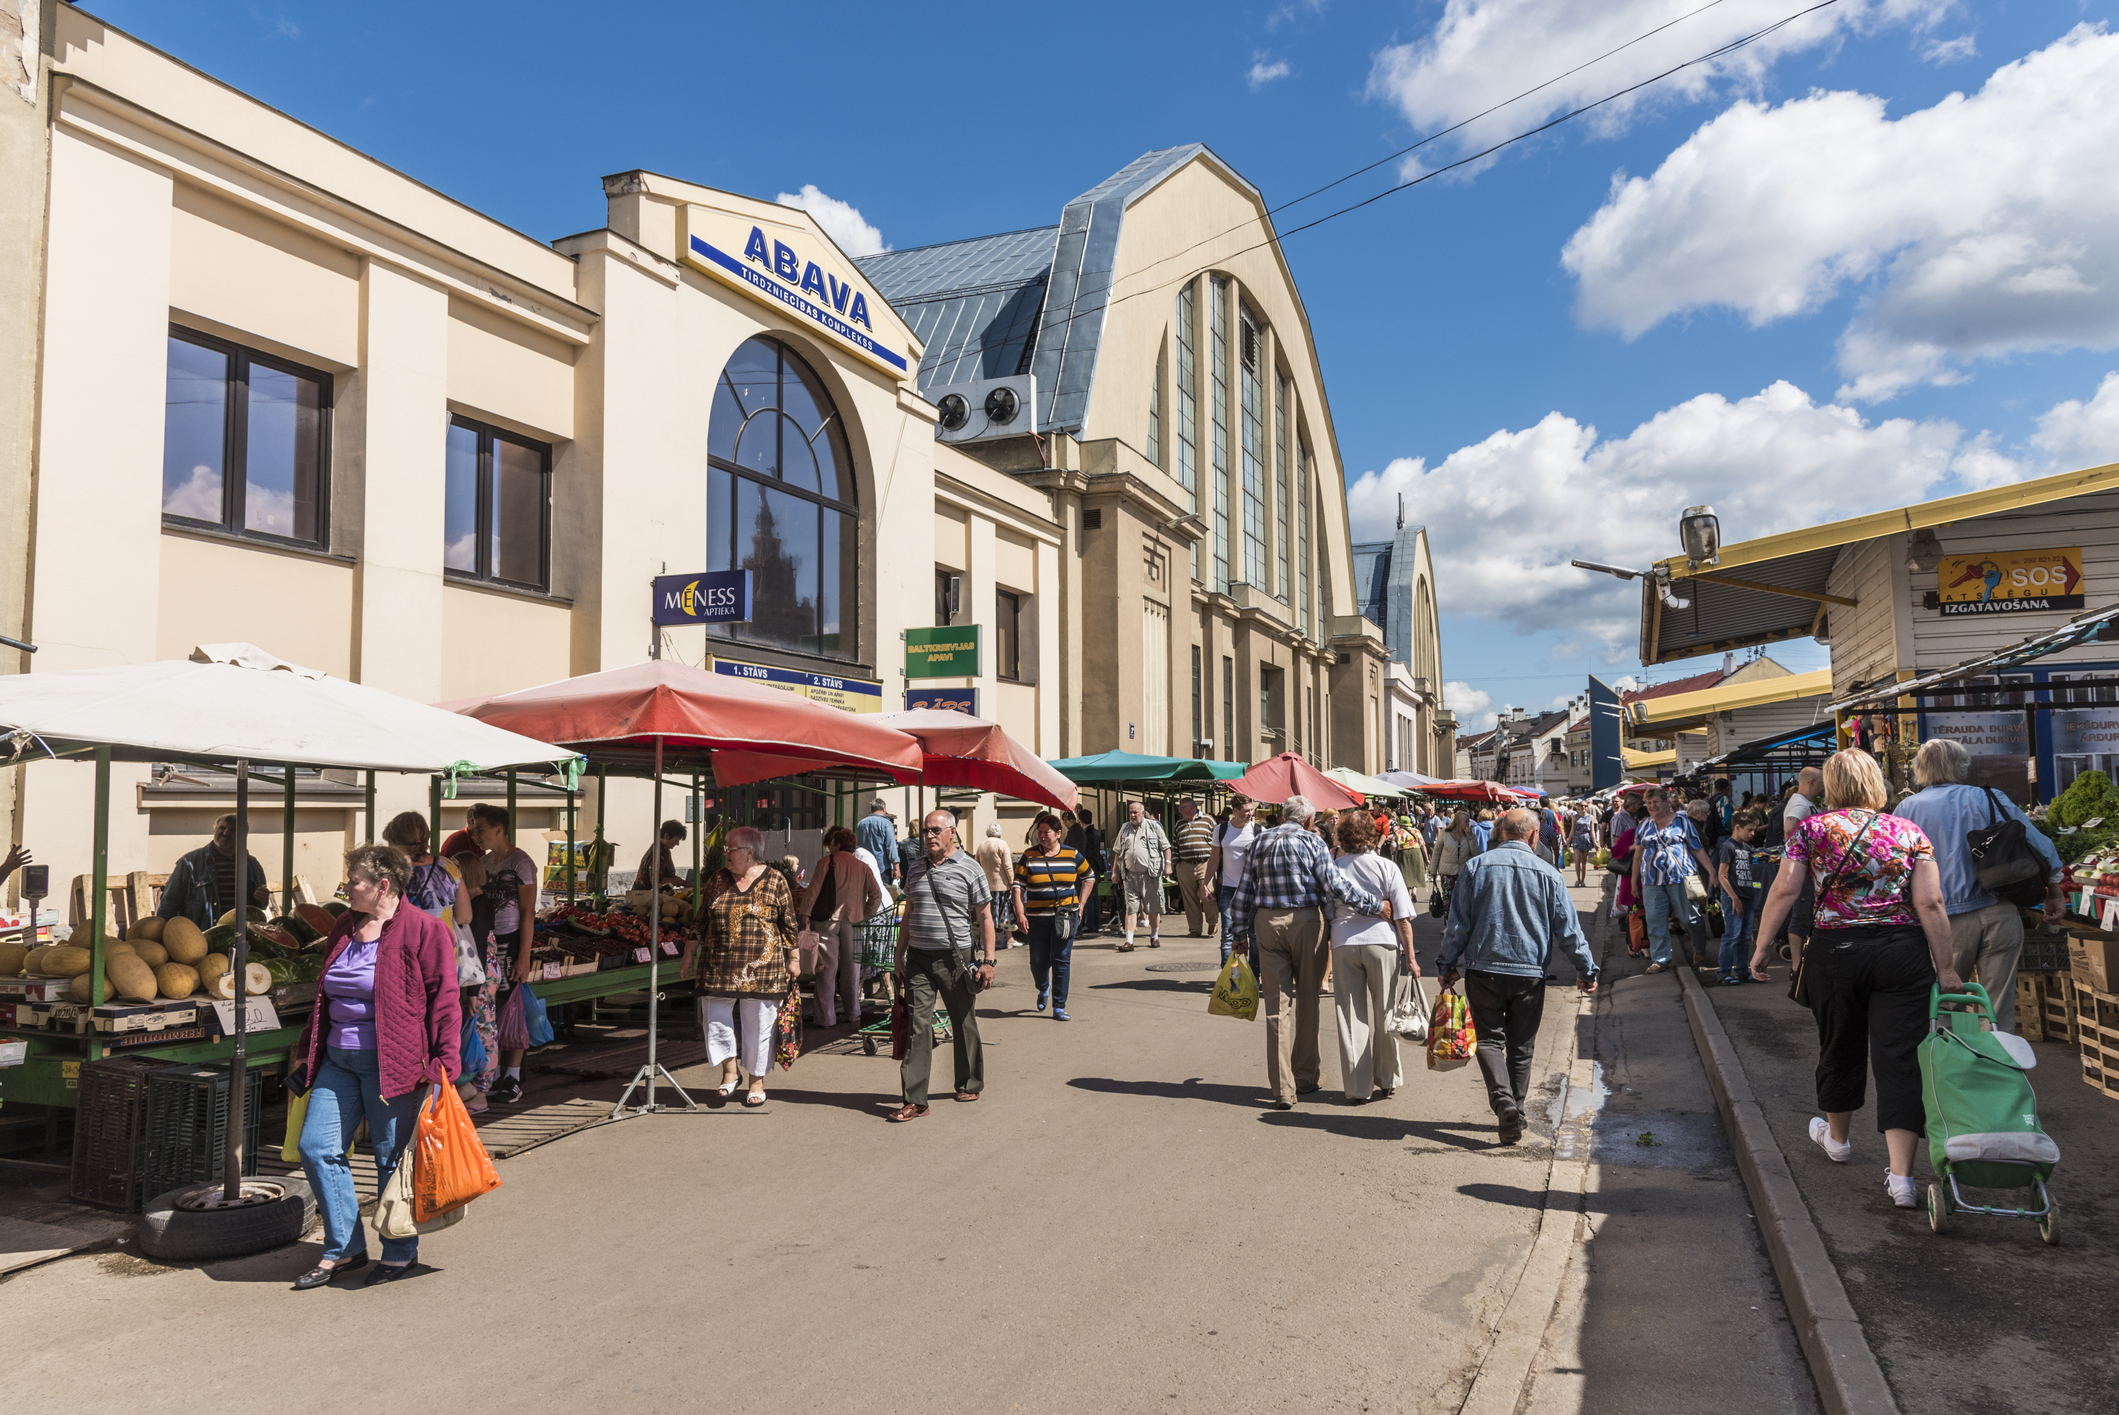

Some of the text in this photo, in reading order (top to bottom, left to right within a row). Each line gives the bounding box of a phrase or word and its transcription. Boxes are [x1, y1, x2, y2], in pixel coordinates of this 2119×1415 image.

[744, 225, 873, 333] ABAVA
[741, 266, 873, 351] TIRDZNIECĪBAS KOMPLEKSS
[2011, 565, 2068, 587] SOS
[664, 587, 736, 610] MĒNESS
[1945, 588, 2049, 601] ATSLĒGU
[703, 606, 736, 617] APTIEKA
[1945, 598, 2050, 614] IZGATAVOŠANA
[907, 642, 975, 654] BALTKRIEVIJAS
[927, 653, 954, 662] APAVI
[733, 665, 768, 679] 1. STĀVS
[813, 676, 843, 689] 2. STĀVS
[1932, 724, 2028, 735] TĒRAUDA DURVIS
[1939, 735, 2026, 745] TĀLA DURVIS
